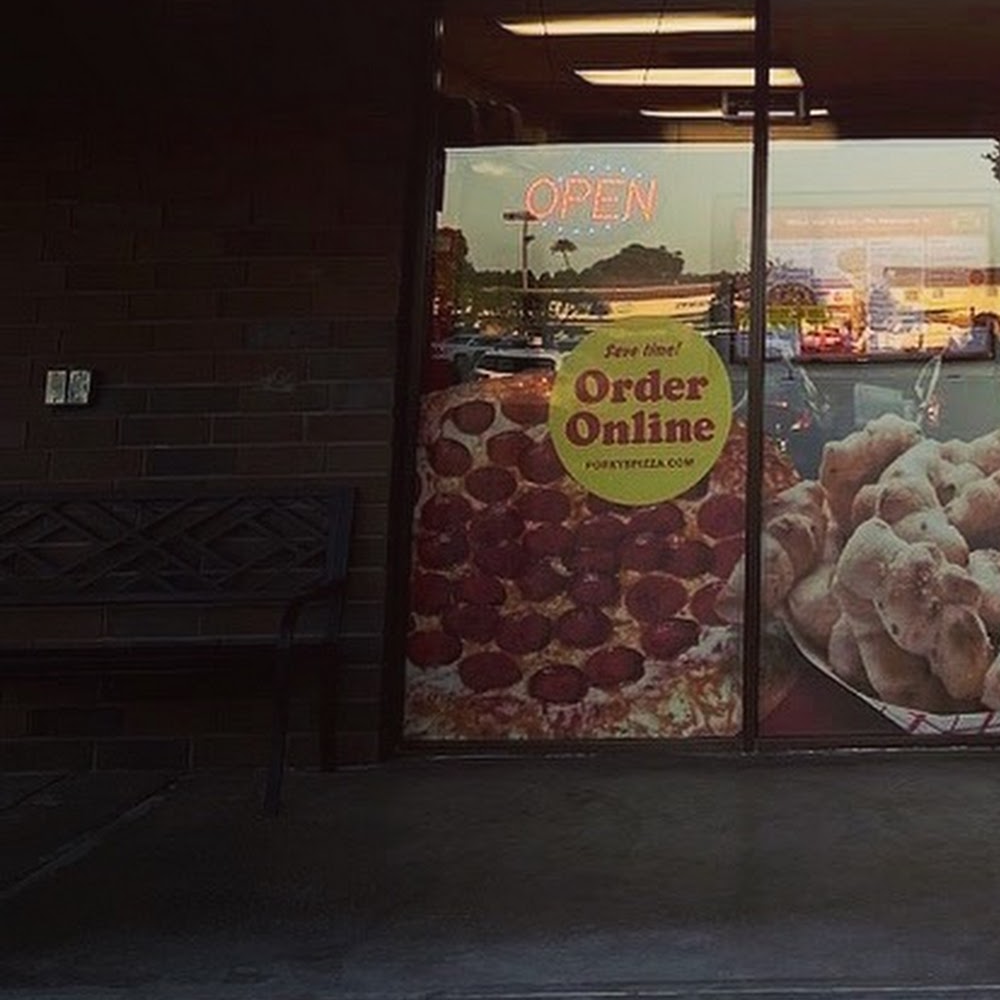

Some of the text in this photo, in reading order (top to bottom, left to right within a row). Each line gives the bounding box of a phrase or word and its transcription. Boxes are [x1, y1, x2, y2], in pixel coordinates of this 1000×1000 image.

[524, 174, 658, 222] OPEN
[575, 369, 709, 404] Order
[565, 410, 715, 447] Online
